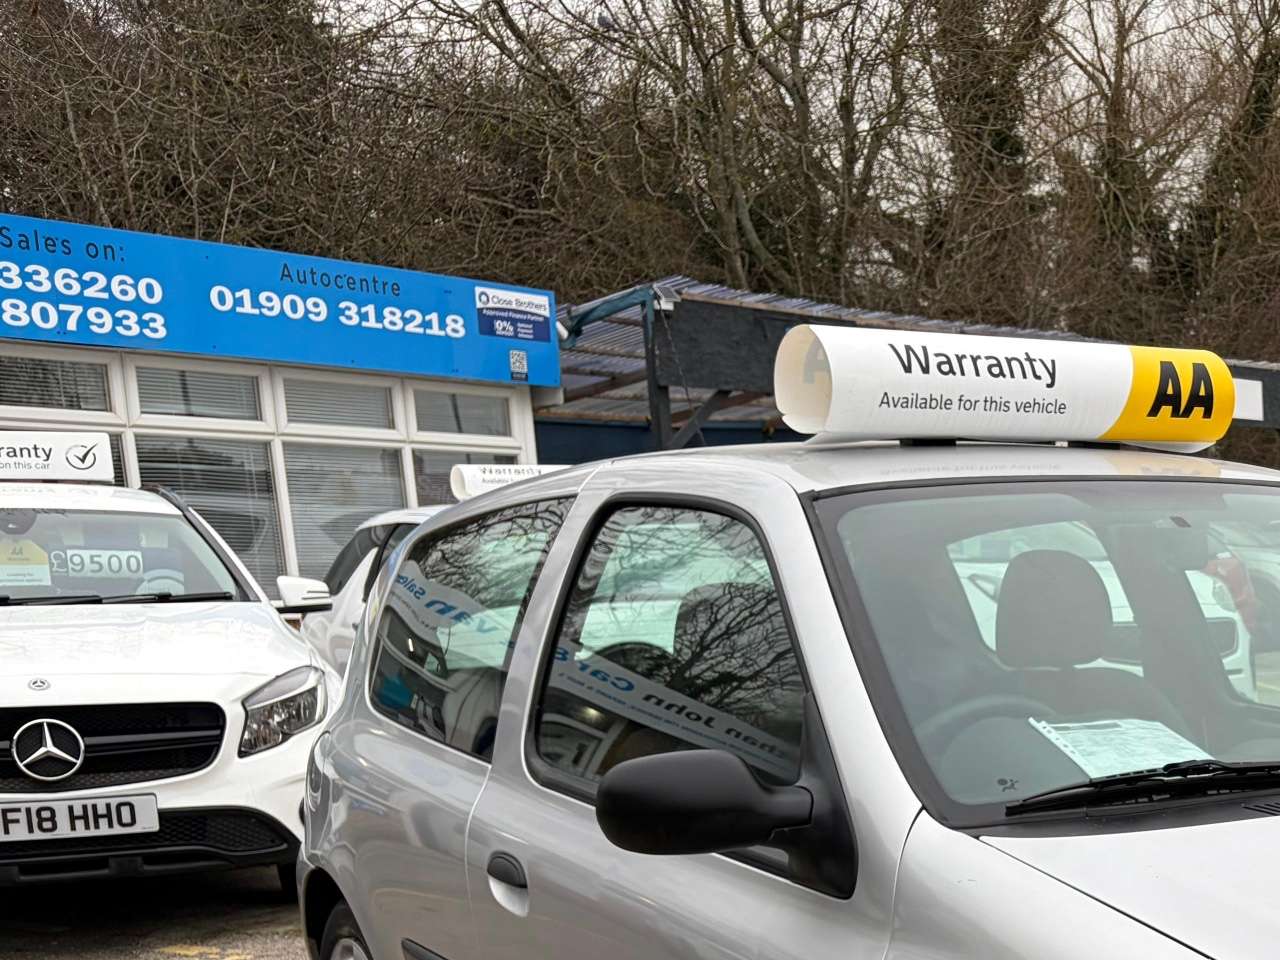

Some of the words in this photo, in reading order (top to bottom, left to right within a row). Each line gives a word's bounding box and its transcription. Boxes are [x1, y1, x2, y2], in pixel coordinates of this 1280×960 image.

[0, 226, 72, 256] Sales
[86, 242, 124, 262] on:
[0, 260, 163, 304] 336260
[280, 263, 401, 297] Autocentre
[1, 298, 167, 339] 807933
[209, 285, 328, 322] 01909
[338, 301, 466, 339] 318218
[888, 343, 1057, 389] Warranty
[879, 392, 953, 411] Available
[958, 395, 980, 411] for
[983, 396, 1011, 413] this
[1015, 398, 1067, 415] vehicle
[1147, 361, 1214, 419] AA
[50, 550, 142, 574] £9500
[1, 806, 58, 835] F18
[68, 801, 137, 832] HHO
